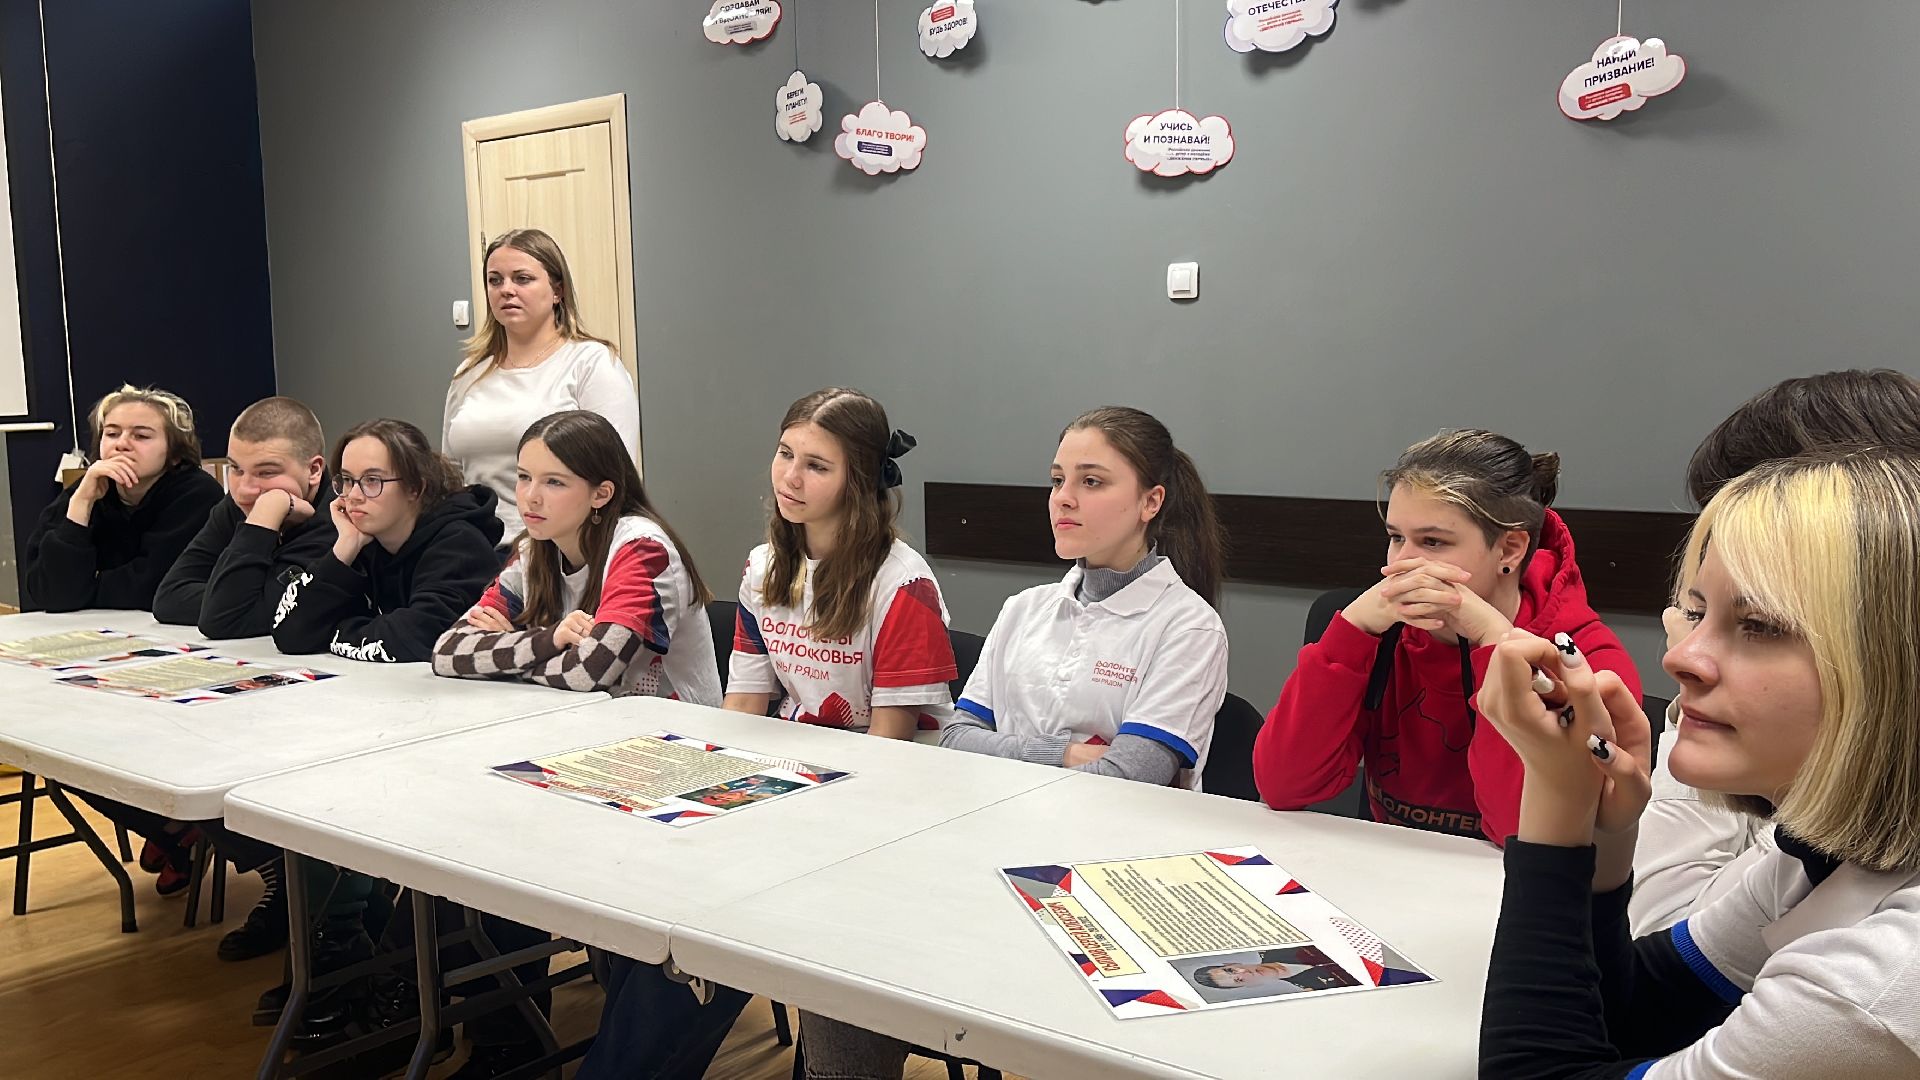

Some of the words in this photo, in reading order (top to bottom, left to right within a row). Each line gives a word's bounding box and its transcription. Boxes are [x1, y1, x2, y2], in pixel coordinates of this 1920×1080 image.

[1248, 0, 1305, 16] ОТЕЧЕС
[1584, 57, 1655, 88] ПРИЗВАНИЕ!
[1160, 122, 1193, 131] УЧИСЬ
[856, 128, 883, 138] БЛАГО
[885, 132, 914, 142] ТВОРИ!
[1143, 135, 1151, 144] И
[1153, 134, 1210, 144] ПОЗНАВАЙ!
[794, 664, 830, 680] РЯДОМ
